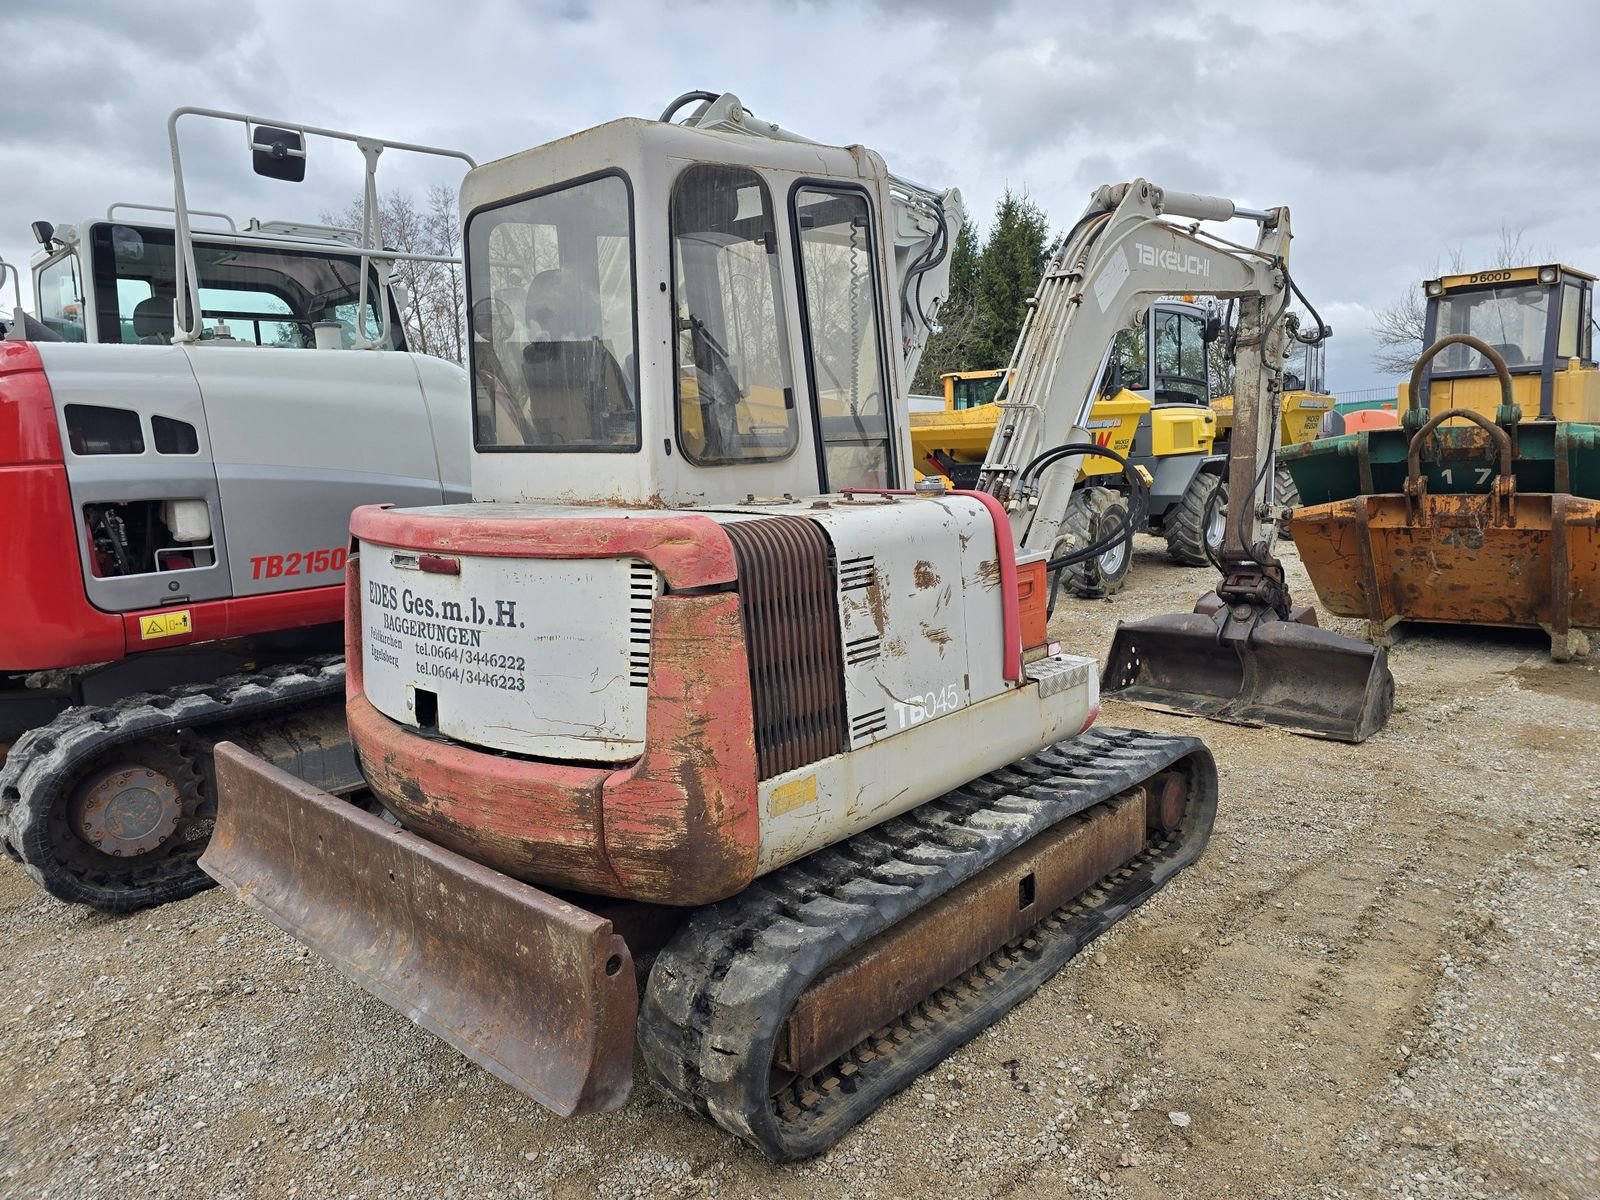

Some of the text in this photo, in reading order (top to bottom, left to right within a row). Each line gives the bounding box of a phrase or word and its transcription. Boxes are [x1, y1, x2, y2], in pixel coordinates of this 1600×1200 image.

[1135, 242, 1210, 277] TAKEUCHI
[249, 547, 347, 581] TB2150
[368, 580, 526, 629] EDES Ges.m.b.H.
[383, 612, 481, 648] BAGGERUNGEN
[415, 641, 526, 671] tel.0664/3446222
[416, 660, 526, 692] tel.0664/3446223
[893, 683, 959, 729] TB045
